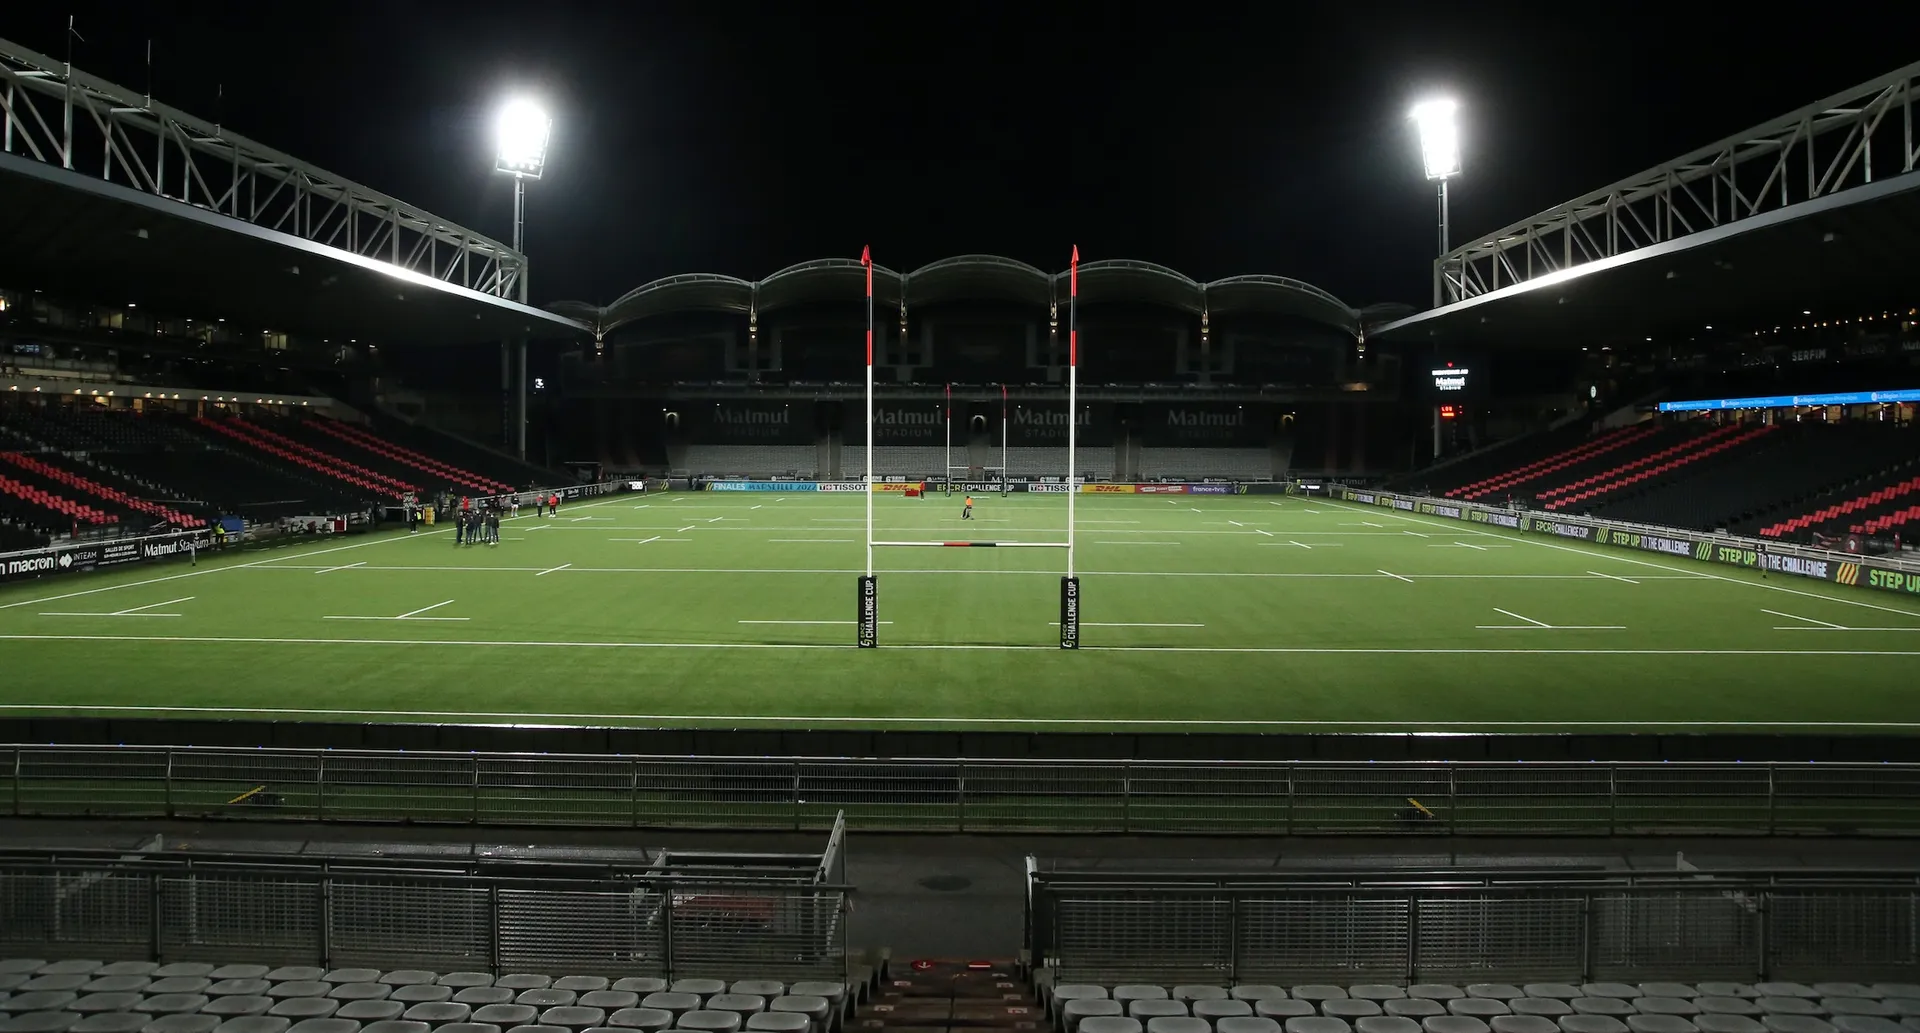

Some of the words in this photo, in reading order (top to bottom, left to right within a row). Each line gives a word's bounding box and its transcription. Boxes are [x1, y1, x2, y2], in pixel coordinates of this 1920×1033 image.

[1792, 349, 1827, 362] SERFIM
[714, 408, 789, 424] Matmut
[866, 408, 942, 425] Matmut
[1014, 409, 1091, 426] Matmut
[1168, 410, 1243, 426] Matmut
[877, 429, 932, 438] STADIUM
[713, 483, 745, 491] FINALES
[749, 483, 794, 491] MARSEILLE
[797, 483, 817, 491] 2022
[967, 484, 1001, 492] CHALLENGE
[1471, 511, 1482, 521] STEP
[1482, 512, 1488, 523] UP
[1499, 514, 1518, 528] CHALLENGE
[1536, 521, 1551, 533] EPCR
[1555, 523, 1580, 536] CHALLENGE
[1579, 527, 1589, 538] CUP
[145, 541, 177, 557] Matmut
[178, 538, 209, 552] Staium
[1612, 532, 1630, 546] STEP
[1630, 534, 1640, 548] UP
[1640, 535, 1648, 549] TO
[1648, 536, 1658, 551] THE
[1658, 538, 1690, 556] CHALLENGE
[9, 557, 54, 574] macron
[1719, 547, 1742, 564] STEP
[1743, 550, 1757, 566] UP
[1768, 554, 1781, 570] THE
[1782, 556, 1827, 578] CHALLENGE
[1870, 569, 1904, 589] STEP
[865, 580, 874, 596] CUP
[1067, 581, 1076, 597] CUP
[865, 596, 874, 639] CHALLENGE
[1067, 598, 1076, 640] CHALLENGE
